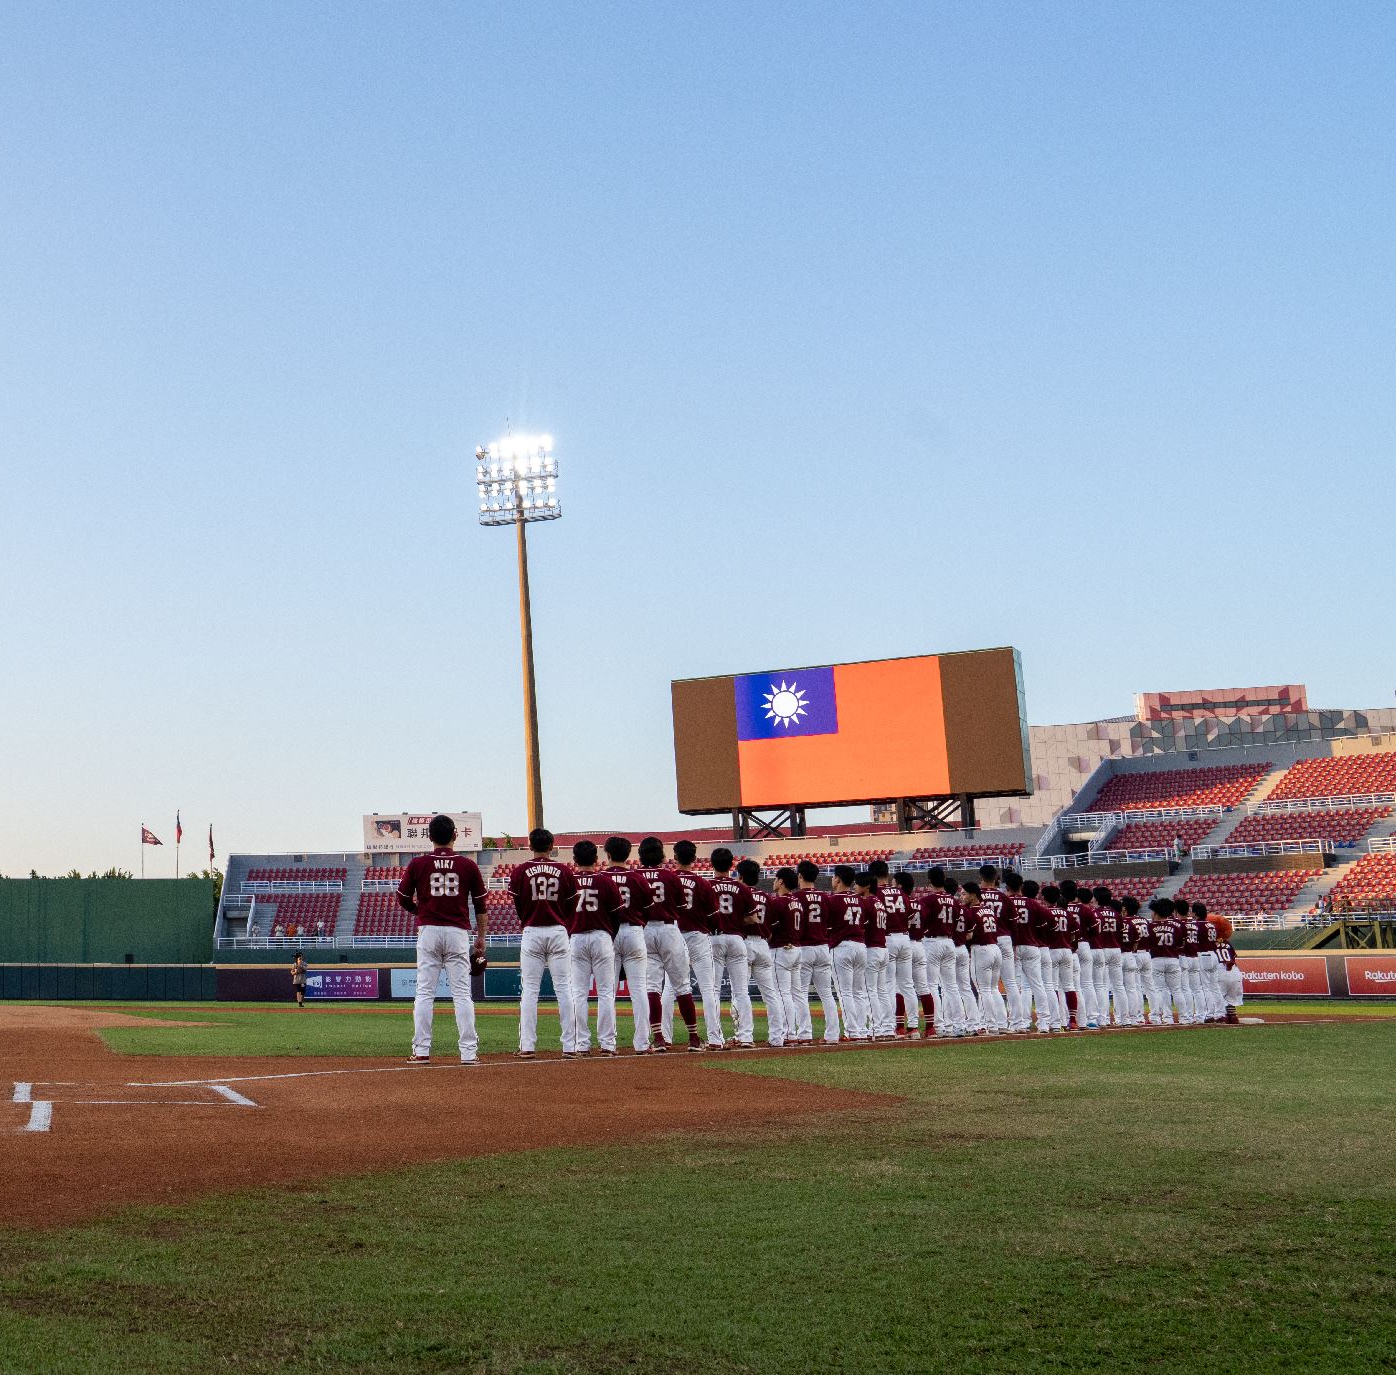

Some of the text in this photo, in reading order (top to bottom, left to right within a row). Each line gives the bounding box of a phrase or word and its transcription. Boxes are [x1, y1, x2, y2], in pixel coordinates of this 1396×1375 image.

[434, 860, 454, 870] MIKI
[430, 872, 460, 897] 88
[530, 877, 559, 902] 132
[575, 889, 599, 913] 75
[719, 894, 733, 914] 8
[885, 896, 906, 913] 54
[808, 904, 821, 923] 2
[843, 907, 862, 926] 47
[1216, 948, 1231, 962] 10
[1281, 971, 1305, 981] kobo
